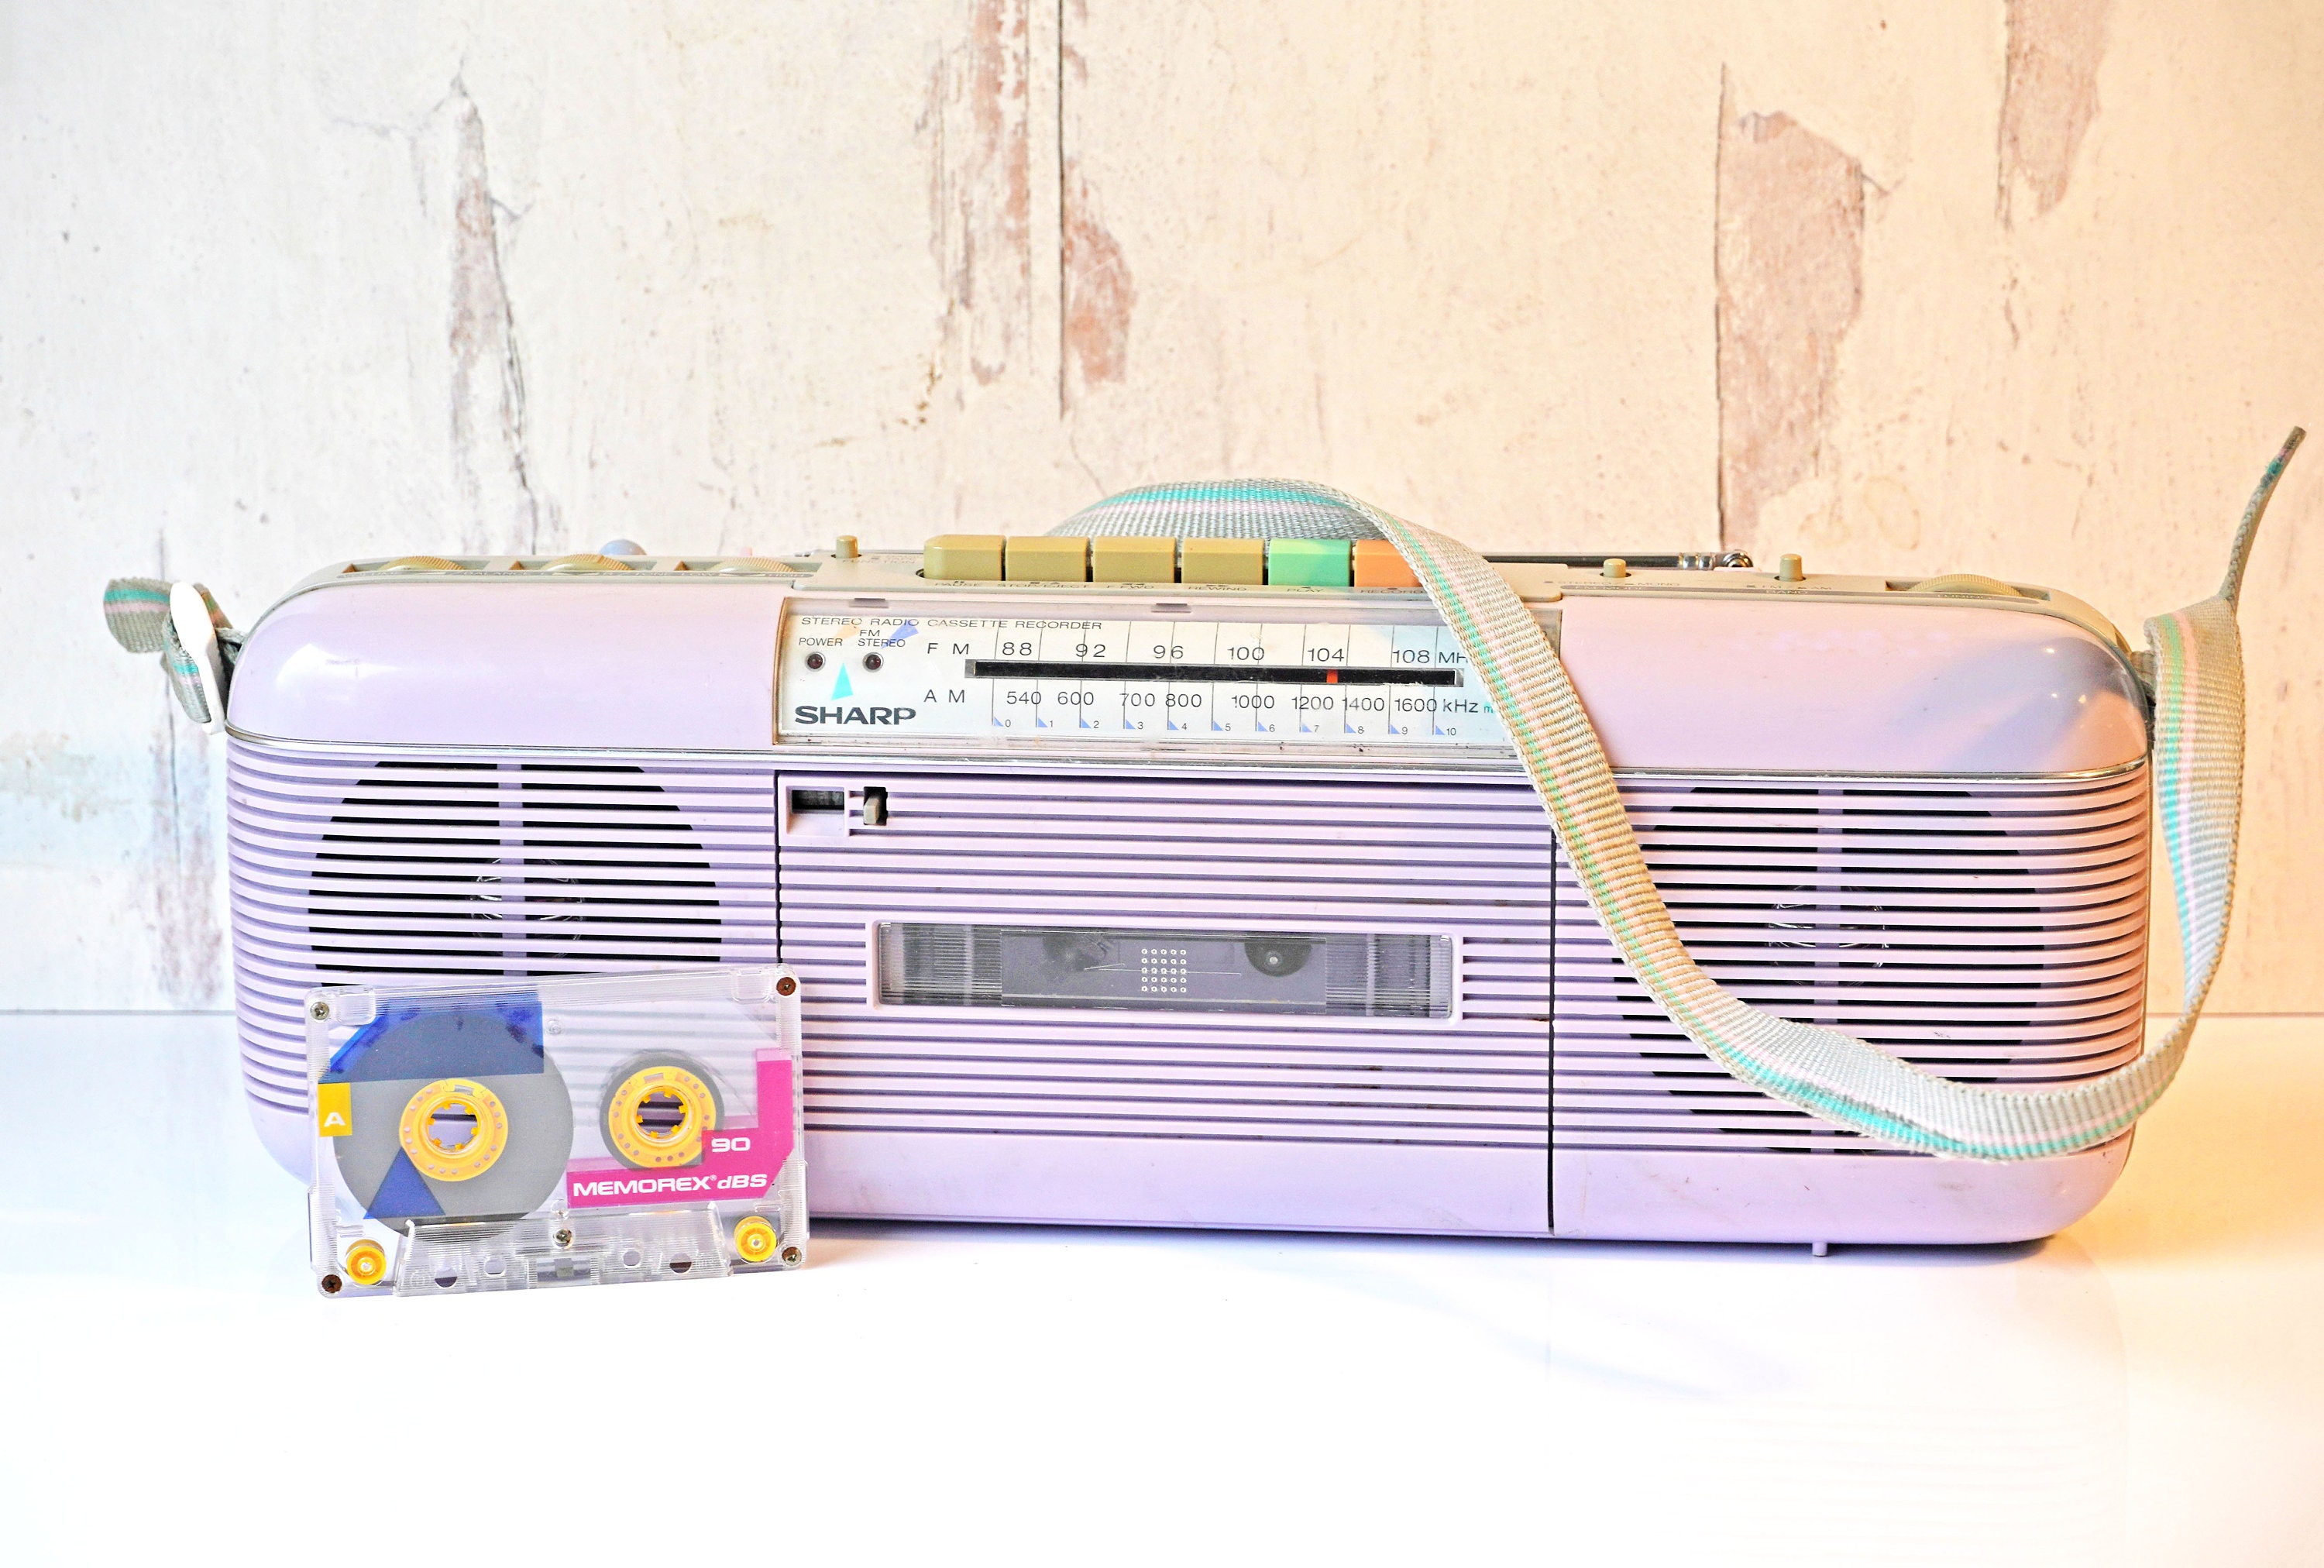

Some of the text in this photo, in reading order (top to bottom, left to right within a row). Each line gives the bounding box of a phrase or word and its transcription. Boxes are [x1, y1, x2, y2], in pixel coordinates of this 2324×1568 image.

[801, 617, 1103, 630] STEREO RADIO CASSETTE RECORDER
[798, 638, 844, 647] POWER
[857, 639, 906, 648] STEREO
[1001, 642, 1033, 657] 88
[1074, 644, 1107, 658] 92
[1153, 645, 1184, 659] 96
[1227, 646, 1266, 662] 100
[1307, 648, 1346, 663] 104
[1392, 649, 1431, 665] 108
[1439, 652, 1469, 664] MH
[1006, 690, 1043, 706] 540
[1057, 691, 1095, 707] 600
[1119, 693, 1156, 708] 700
[1164, 693, 1203, 708] 800
[1231, 694, 1276, 710] 1000
[1291, 695, 1335, 711] 1200
[1342, 696, 1386, 712] 1400
[1394, 697, 1439, 714] 1600
[1442, 698, 1479, 714] kHz
[794, 705, 917, 725] SHARP
[1004, 718, 1457, 736] 0 1 2 3 4 5 6 7 8 9 10
[323, 1112, 346, 1127] A
[710, 1136, 751, 1153] 90
[717, 1174, 768, 1190] dBS
